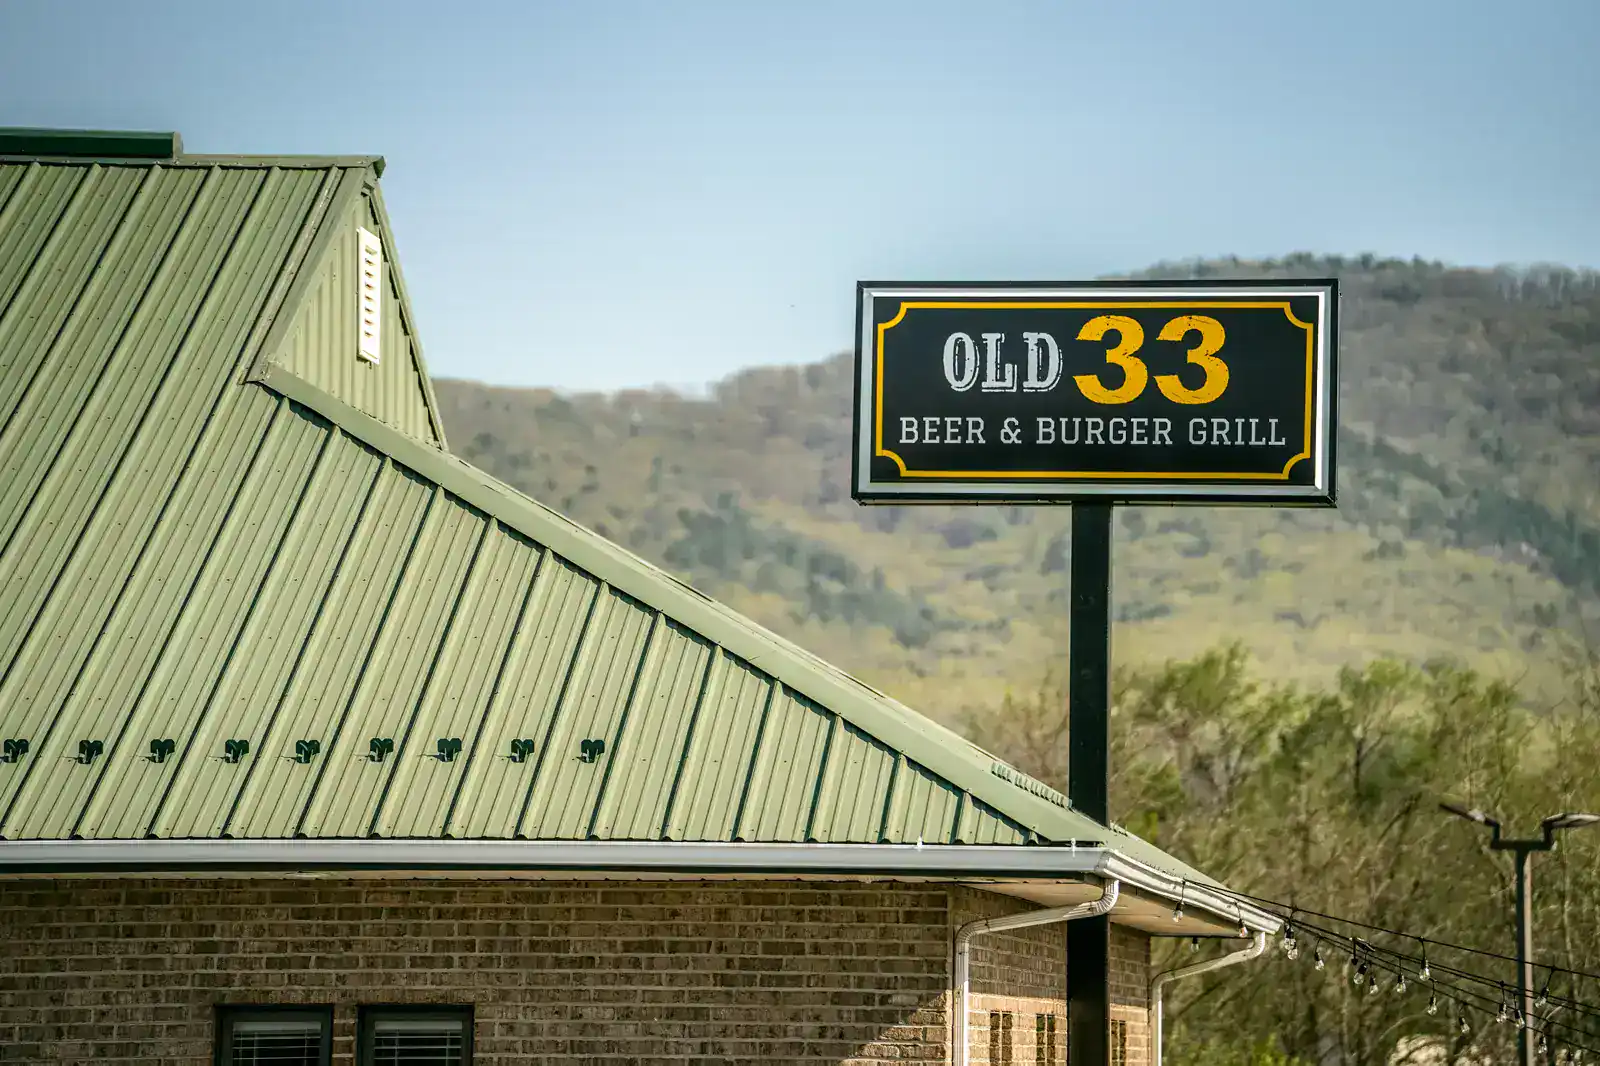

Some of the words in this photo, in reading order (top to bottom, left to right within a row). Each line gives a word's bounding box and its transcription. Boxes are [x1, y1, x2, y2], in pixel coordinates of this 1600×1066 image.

[942, 331, 1063, 393] OLD
[1073, 315, 1230, 405] 33
[899, 417, 986, 444] BEER
[1000, 417, 1022, 444] &
[1036, 417, 1173, 446] BURGER
[1188, 418, 1287, 446] GRILL
